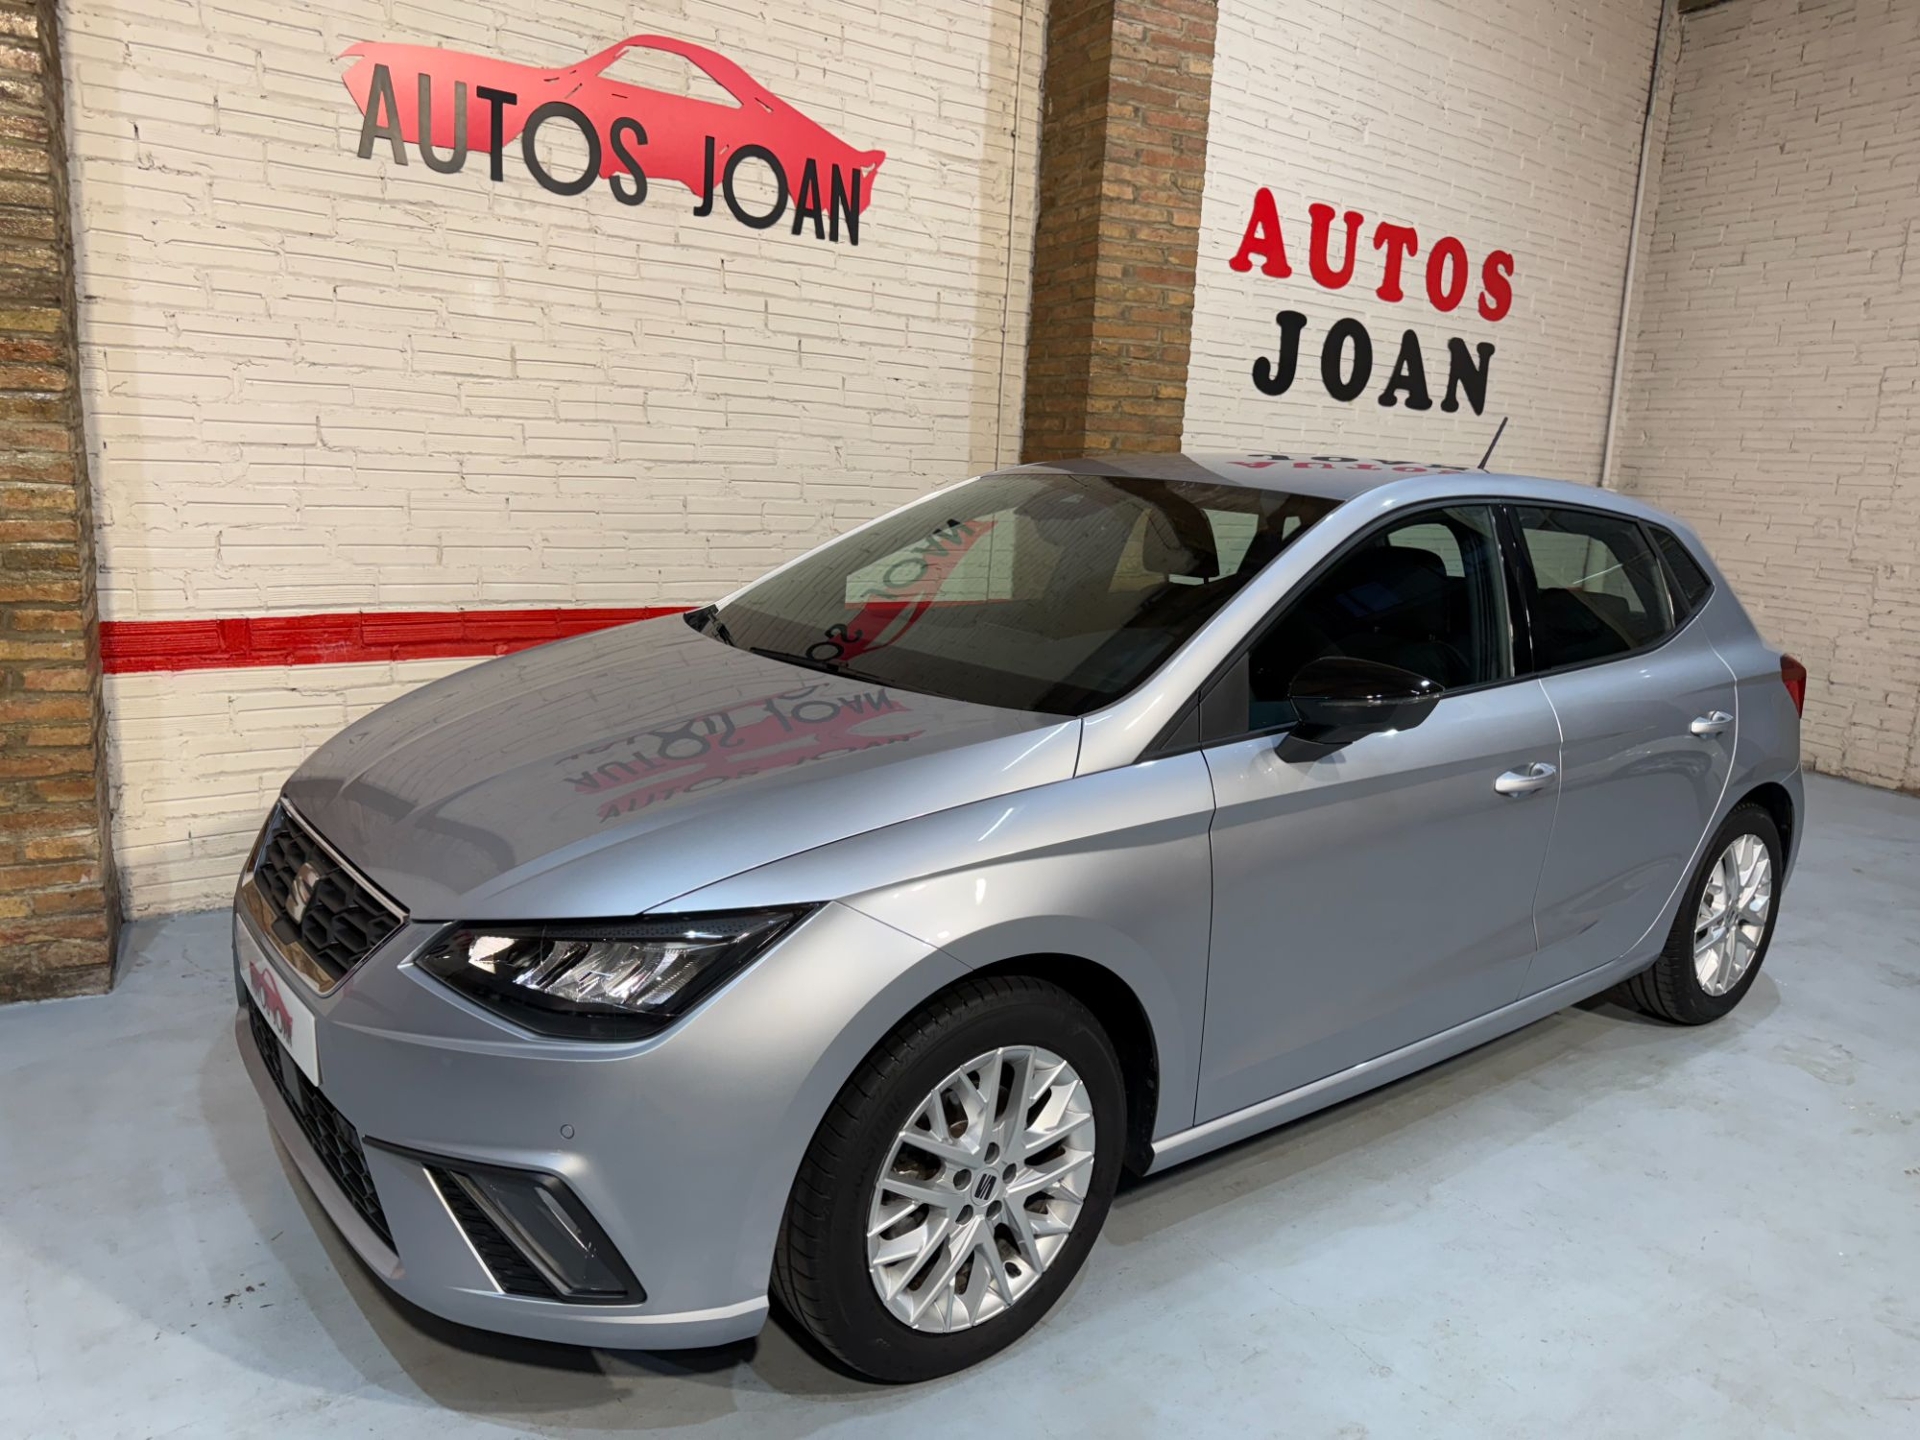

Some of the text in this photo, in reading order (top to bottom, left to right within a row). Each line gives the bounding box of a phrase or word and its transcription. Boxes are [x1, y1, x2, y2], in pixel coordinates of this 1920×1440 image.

[357, 63, 861, 246] AUTOS JOAN
[1229, 187, 1514, 322] AUTOS
[1252, 310, 1496, 416] JOAN
